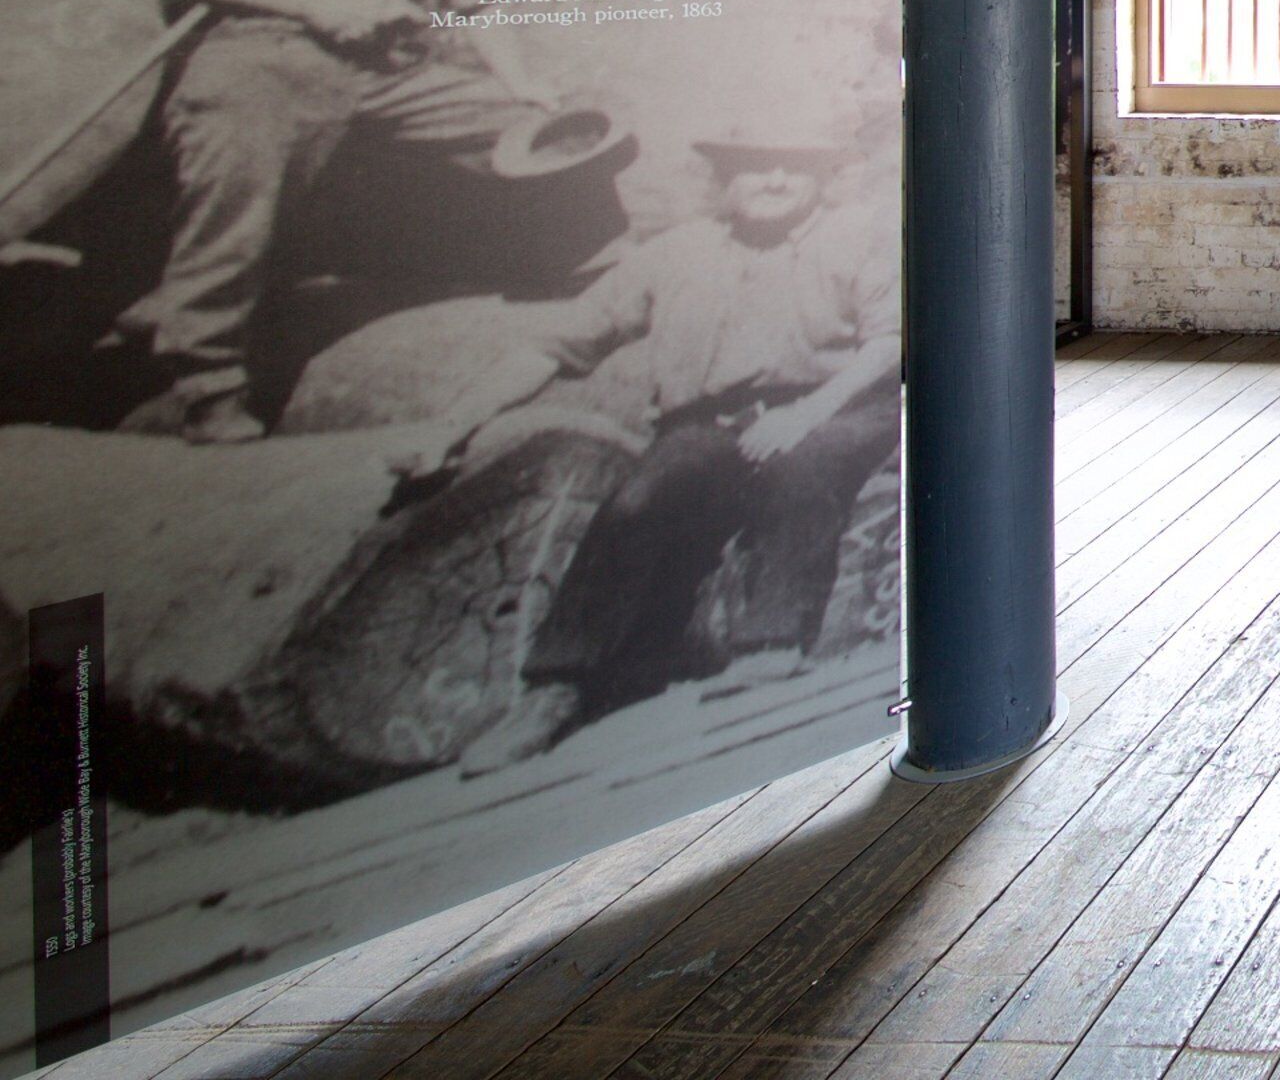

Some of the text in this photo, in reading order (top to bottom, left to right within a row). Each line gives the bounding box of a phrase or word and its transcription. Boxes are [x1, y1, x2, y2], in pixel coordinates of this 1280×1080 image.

[429, 1, 723, 29] Maryborough pioneer, 1863
[76, 661, 92, 690] Society
[76, 691, 90, 728] Historical
[77, 728, 91, 759] Burnett
[77, 767, 93, 784] Bay
[77, 784, 91, 806] Wide
[78, 806, 94, 860] Maryborough
[78, 875, 91, 884] of
[79, 859, 92, 874] the
[62, 881, 76, 914] workers
[79, 884, 95, 919] courtesy
[62, 915, 76, 931] and
[80, 920, 95, 945] Image
[63, 931, 78, 952] Logs
